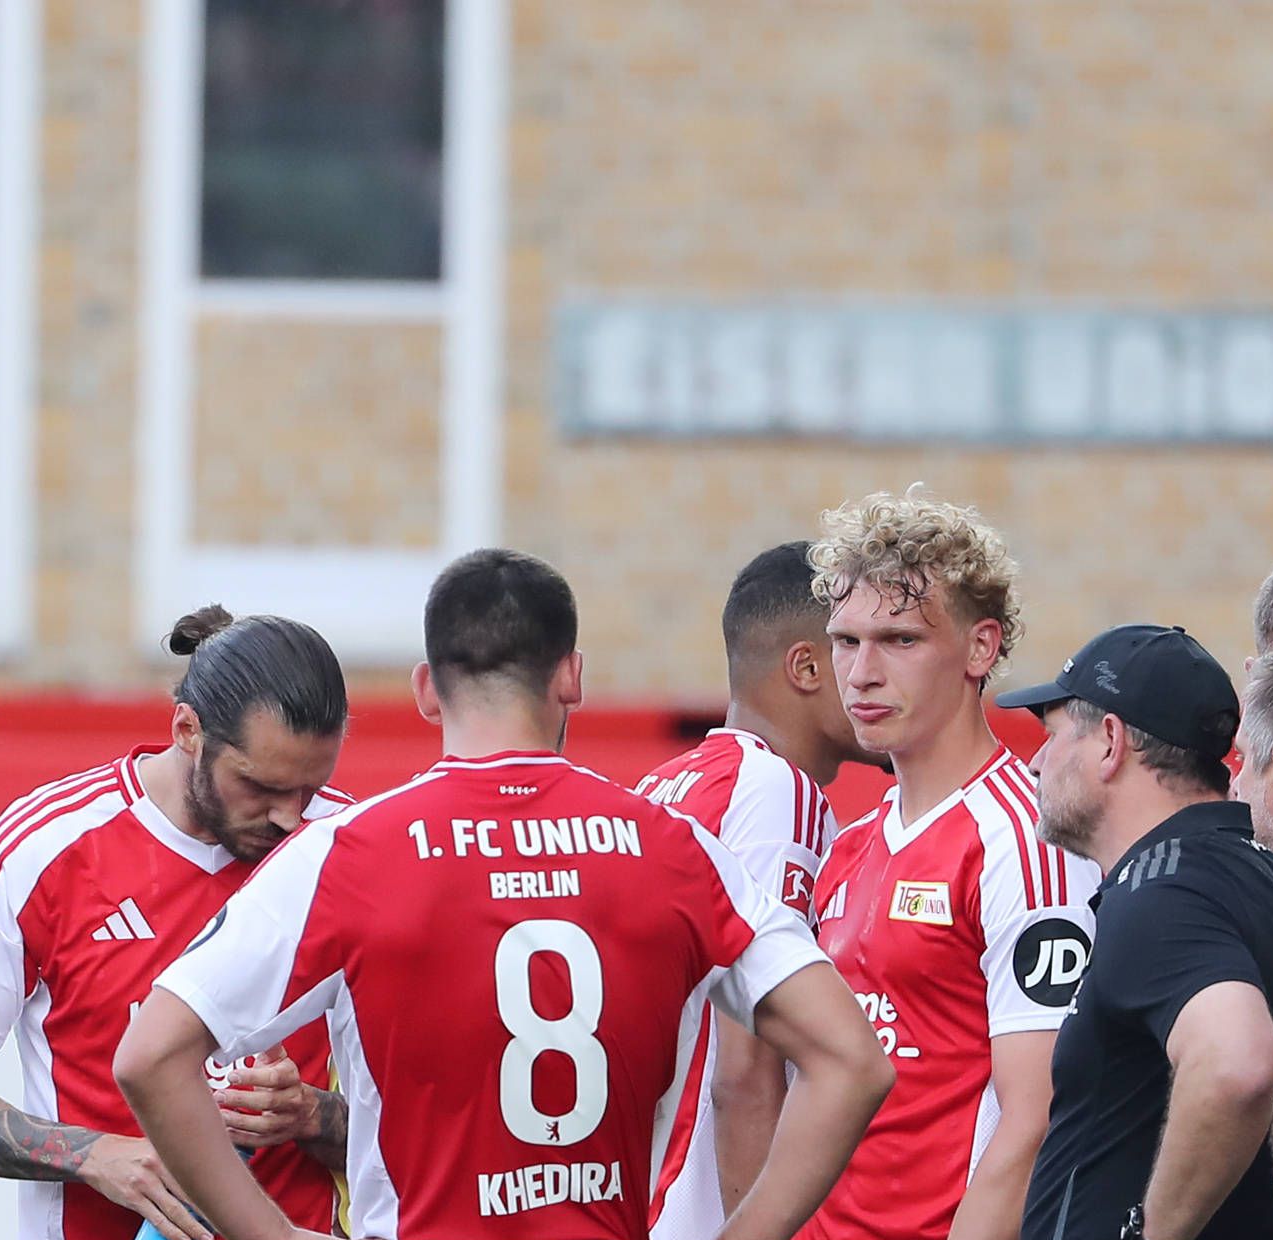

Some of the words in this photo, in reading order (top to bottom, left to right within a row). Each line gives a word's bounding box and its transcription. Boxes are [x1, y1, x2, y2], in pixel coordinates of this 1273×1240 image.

[408, 819, 444, 859] 1.
[451, 819, 503, 857] FC
[512, 815, 642, 858] UNION
[489, 869, 581, 900] BERLIN
[1025, 938, 1087, 988] JD
[495, 918, 609, 1147] 8
[477, 1161, 624, 1217] KHEDIRA
